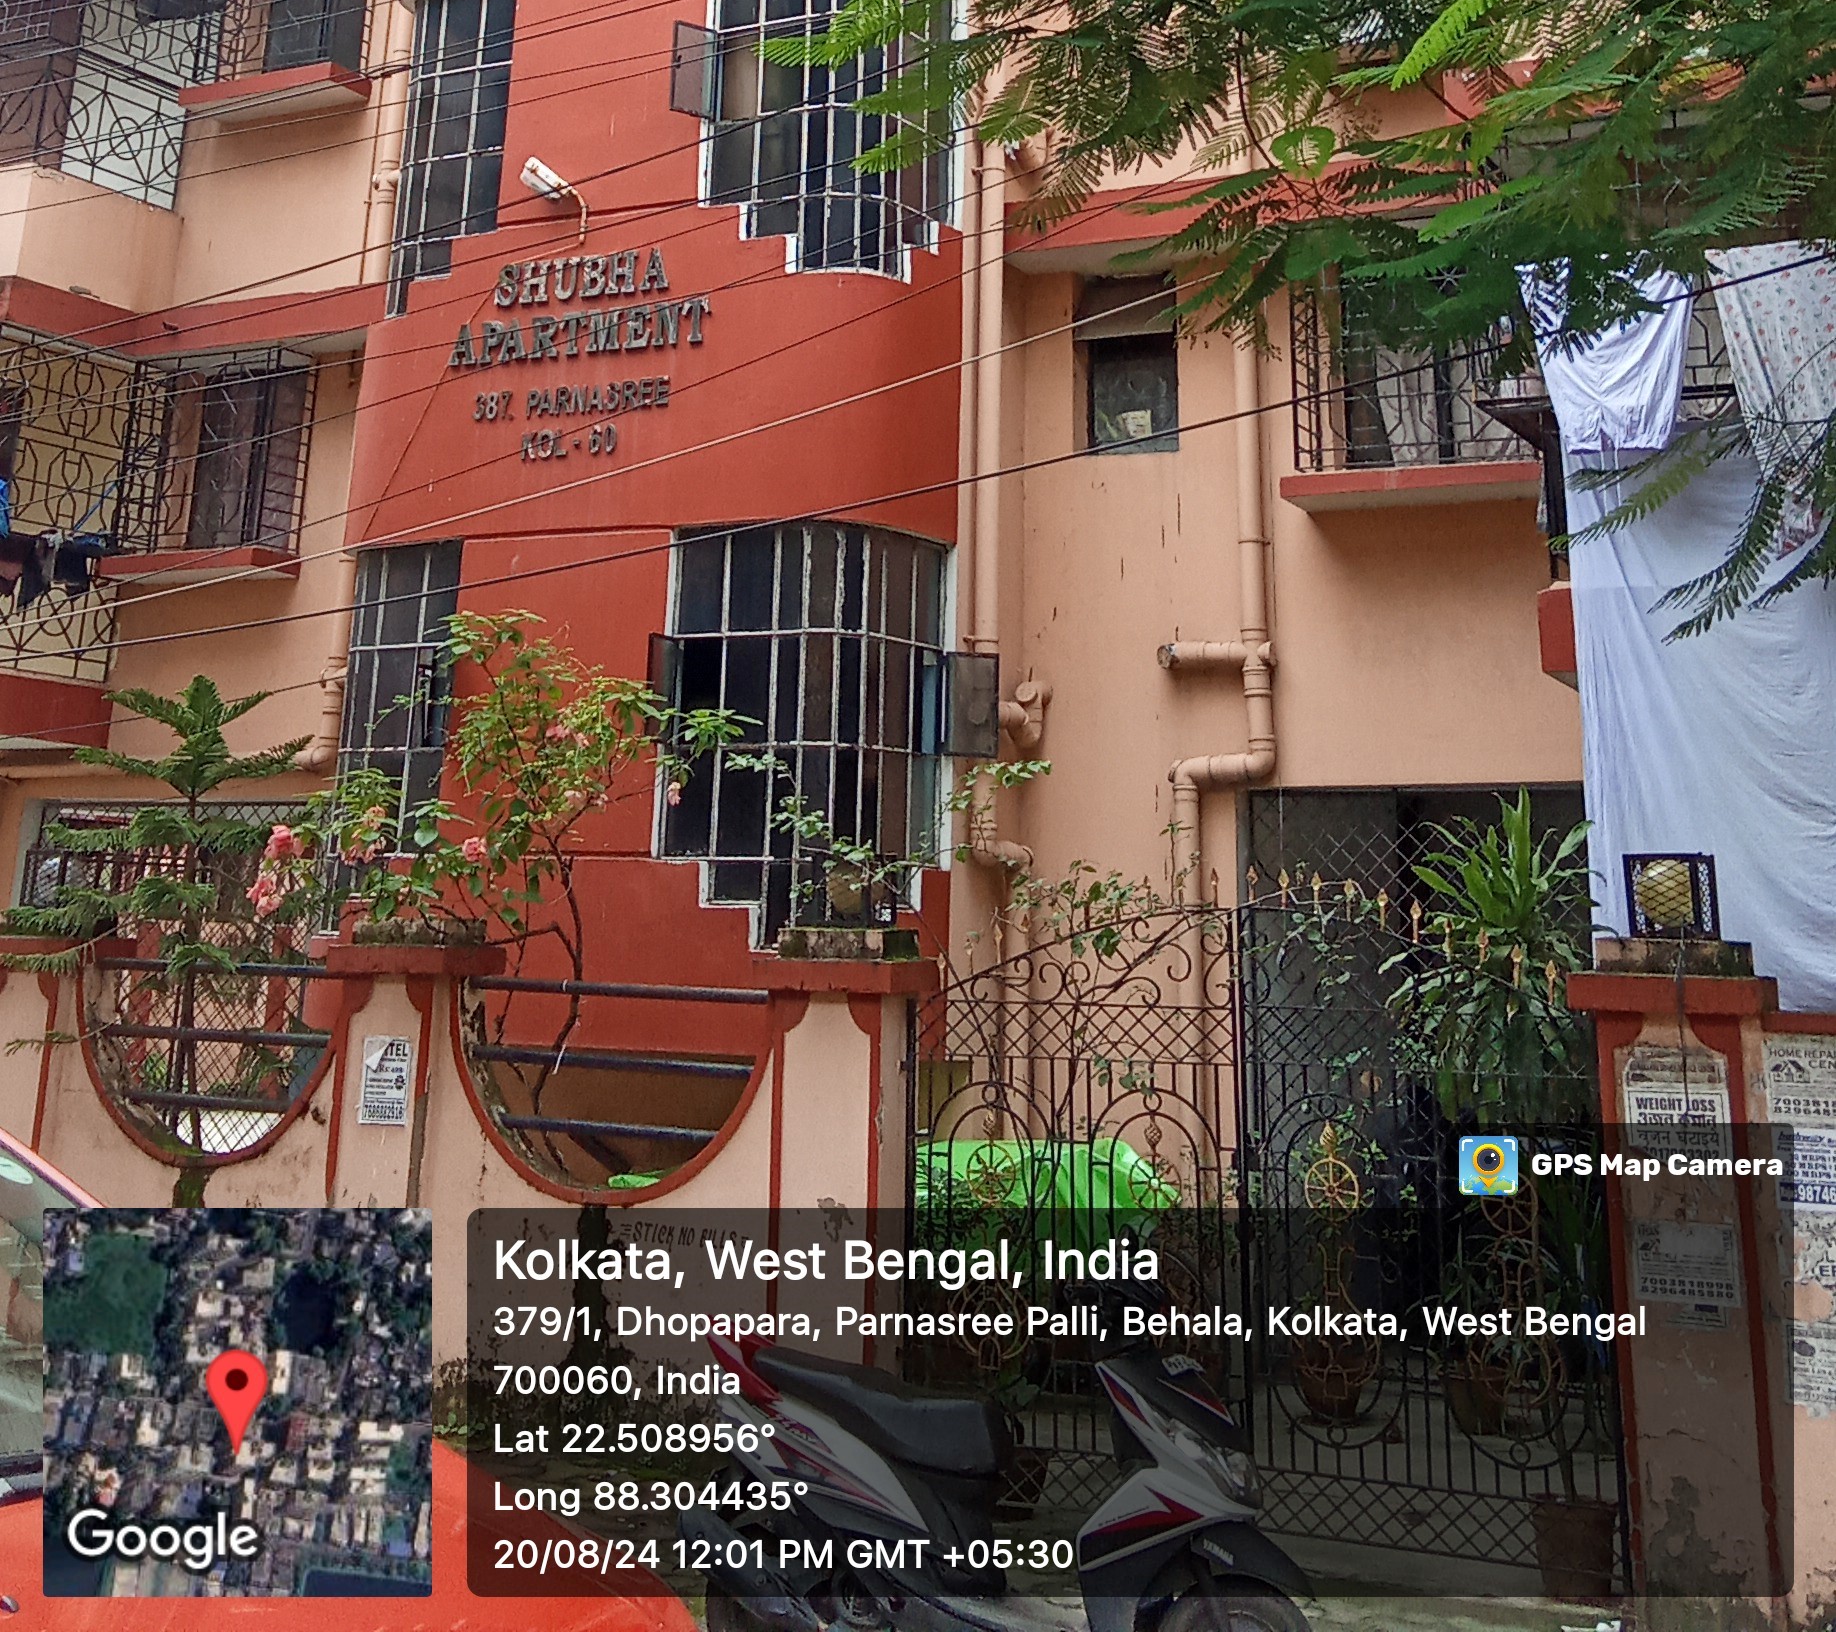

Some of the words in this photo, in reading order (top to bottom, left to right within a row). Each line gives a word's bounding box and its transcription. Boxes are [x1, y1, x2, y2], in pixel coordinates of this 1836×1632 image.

[494, 247, 670, 307] SHUBHA
[449, 294, 714, 367] APARTMENT
[526, 376, 671, 419] PARNASREE
[1769, 1048, 1802, 1058] HOME
[1635, 1097, 1682, 1111] WEIGHT
[1686, 1098, 1716, 1112] LOSS
[632, 1220, 675, 1253] STICK
[678, 1226, 696, 1246] NO
